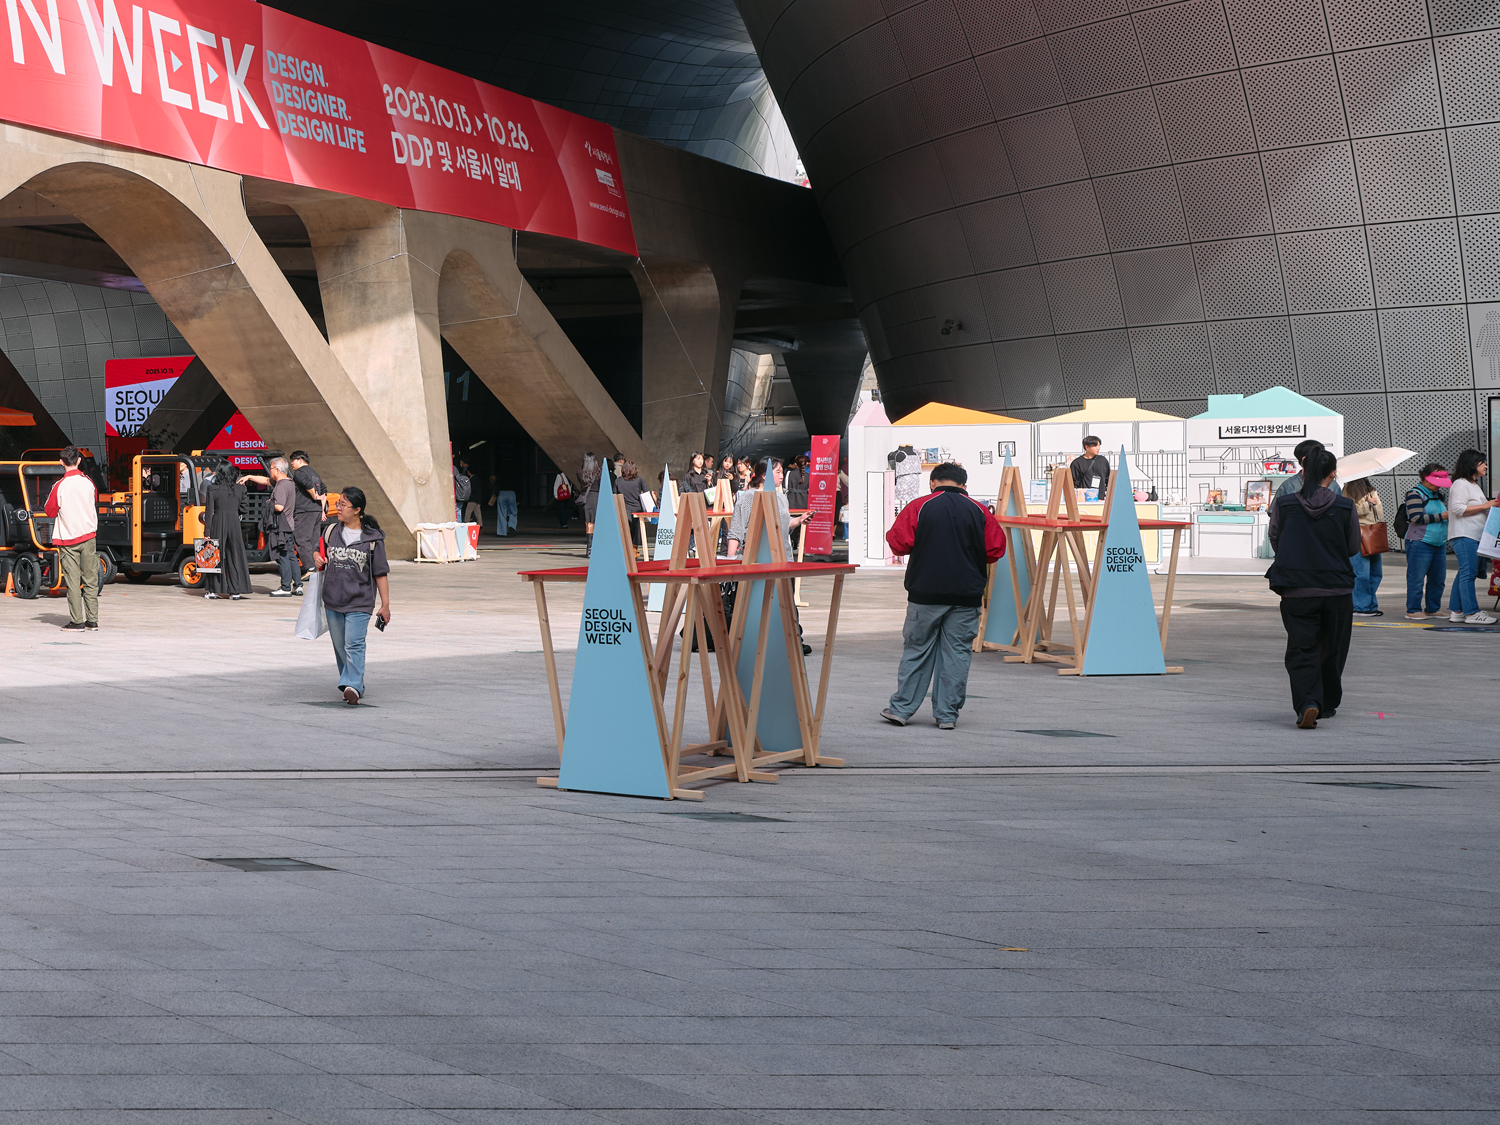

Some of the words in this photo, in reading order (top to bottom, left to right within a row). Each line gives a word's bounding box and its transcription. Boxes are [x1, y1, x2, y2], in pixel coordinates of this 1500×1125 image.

[276, 110, 336, 146] DESIGN
[335, 124, 367, 153] LIFE
[391, 131, 433, 169] DDP
[436, 141, 454, 173] 및
[456, 146, 495, 185] 서울시
[494, 157, 522, 192] 일대
[115, 407, 151, 422] DESI
[1225, 424, 1301, 434] 서울디자인창업센터
[1106, 547, 1139, 556] SEOUL
[1106, 555, 1143, 564] DESIGN
[1106, 564, 1135, 573] WEEK
[585, 608, 627, 620] SEOUL
[585, 620, 632, 633] DESIGN
[585, 633, 622, 645] WEEK
